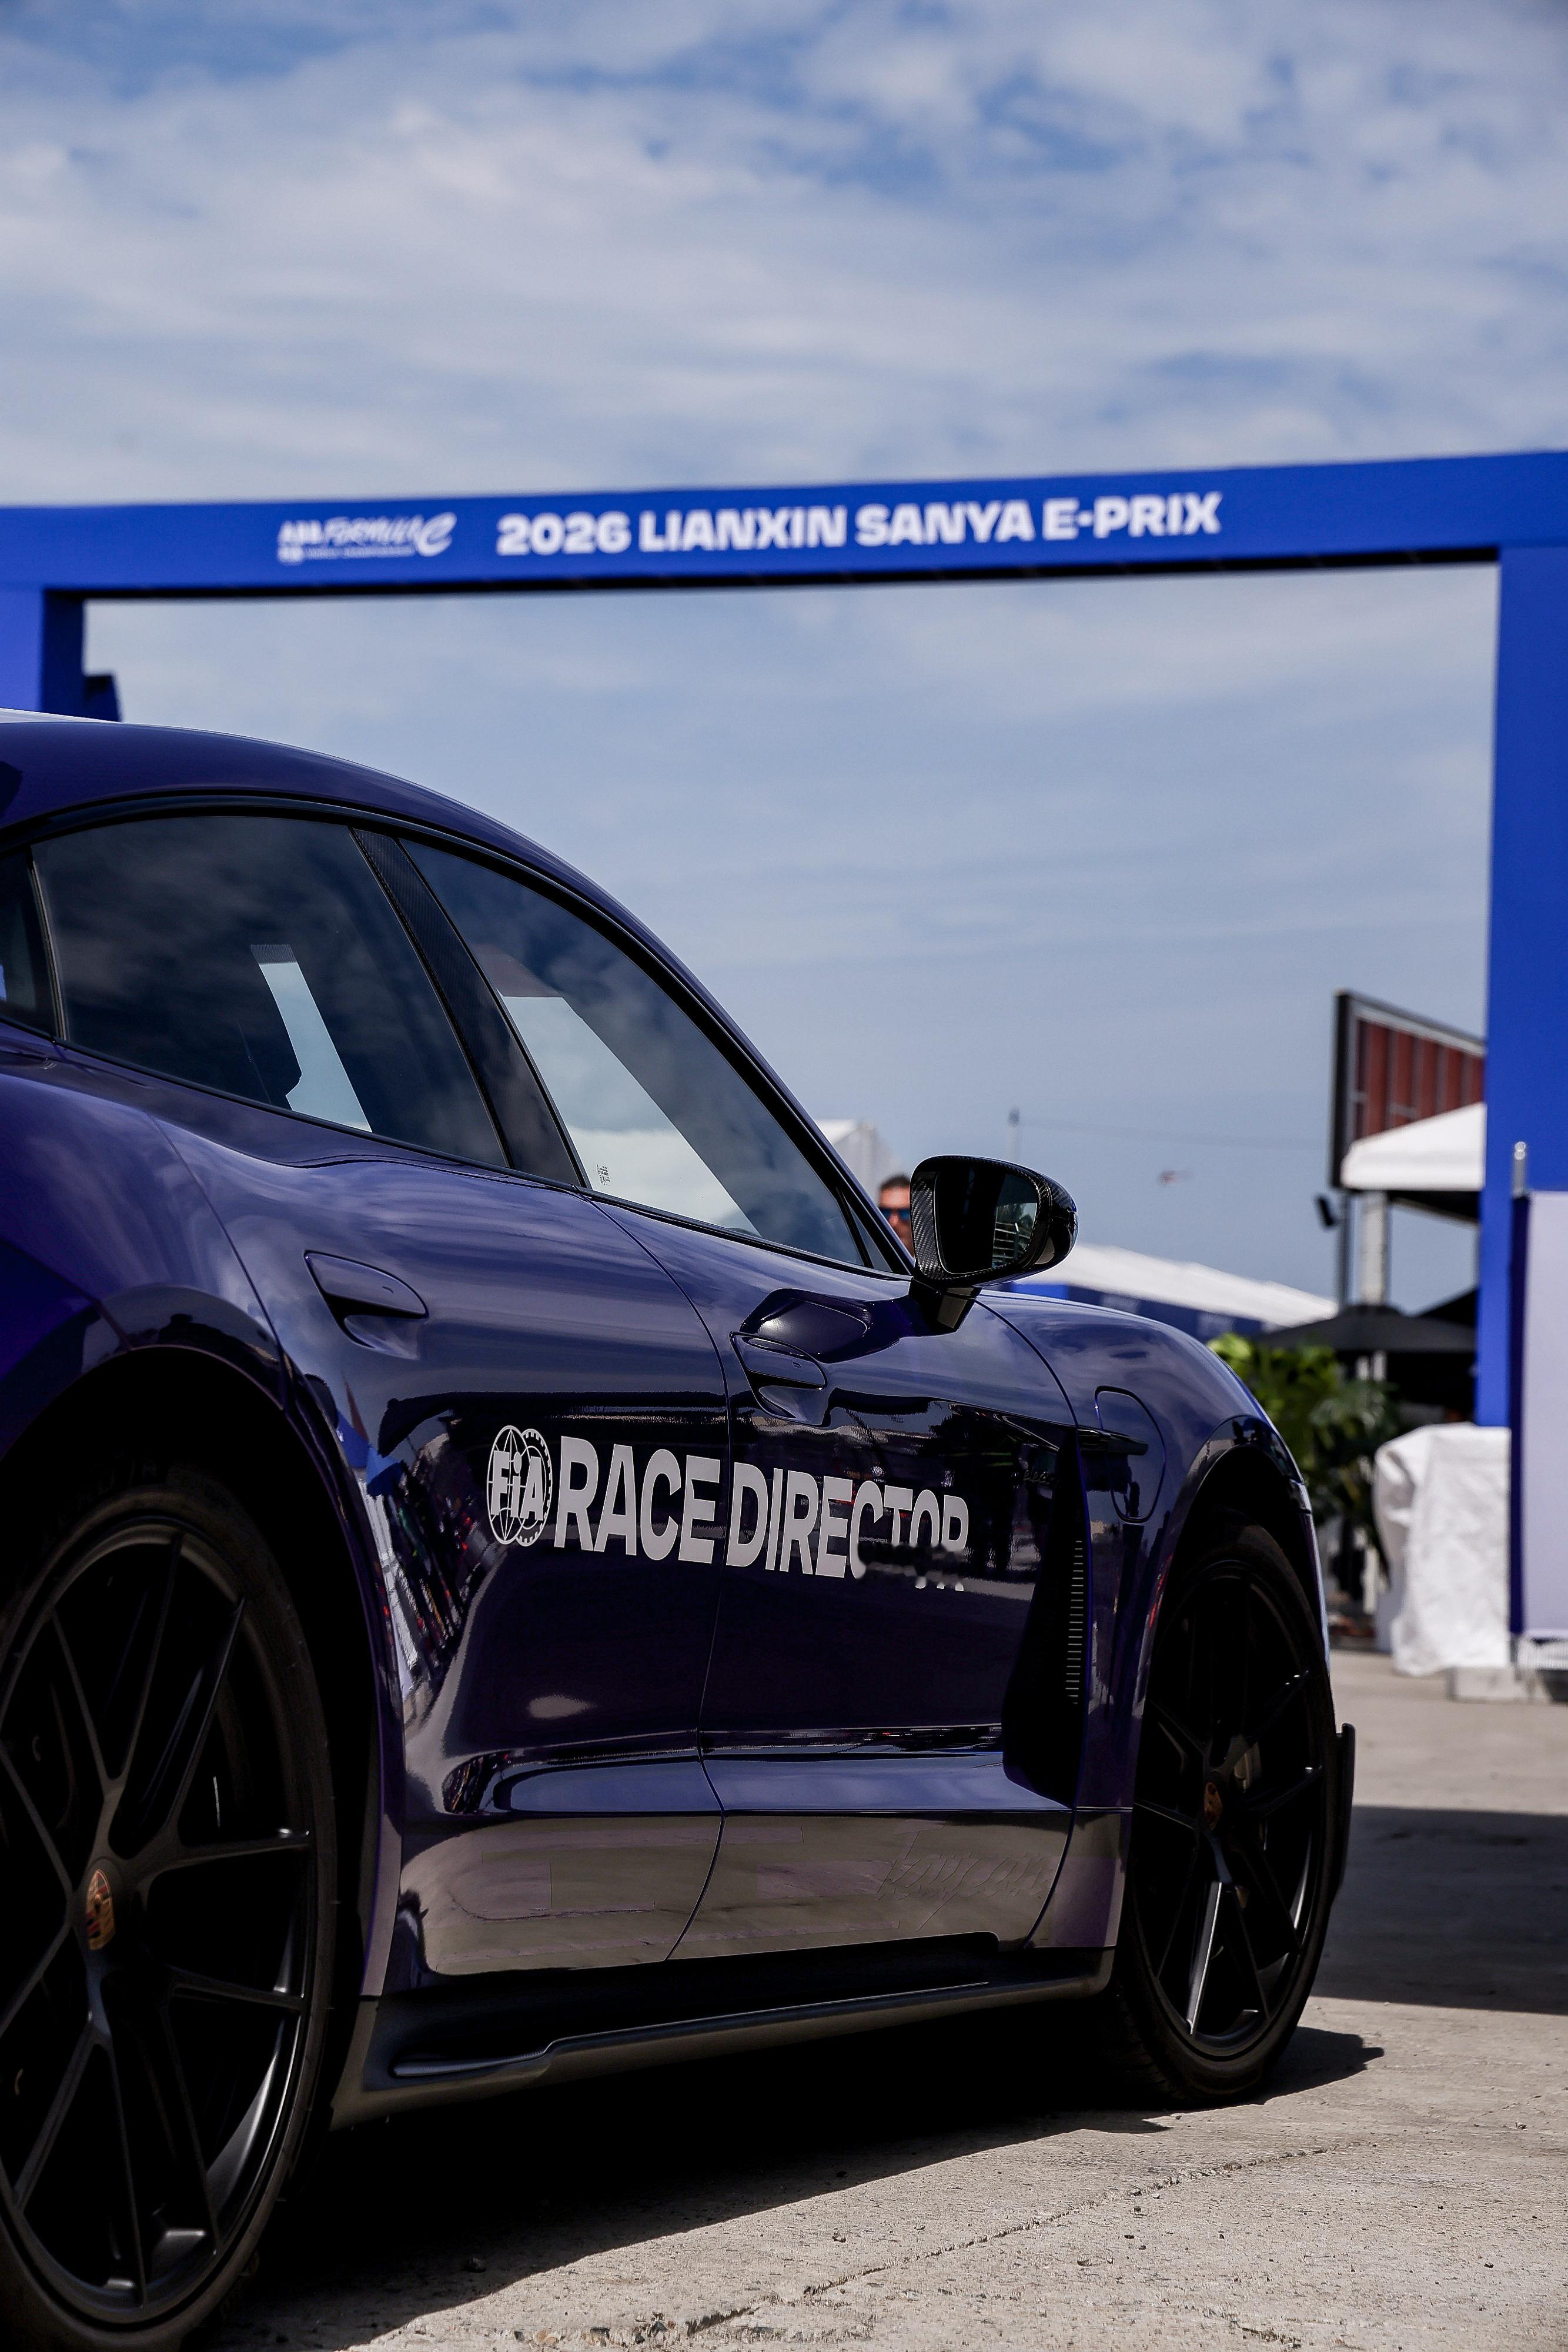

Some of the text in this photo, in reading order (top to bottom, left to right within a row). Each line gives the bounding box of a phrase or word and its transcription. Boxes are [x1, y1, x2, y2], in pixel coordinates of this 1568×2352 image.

[497, 492, 1222, 555] 2026 LIANXIN SANYA E-PRIX
[554, 1435, 720, 1564] RACE
